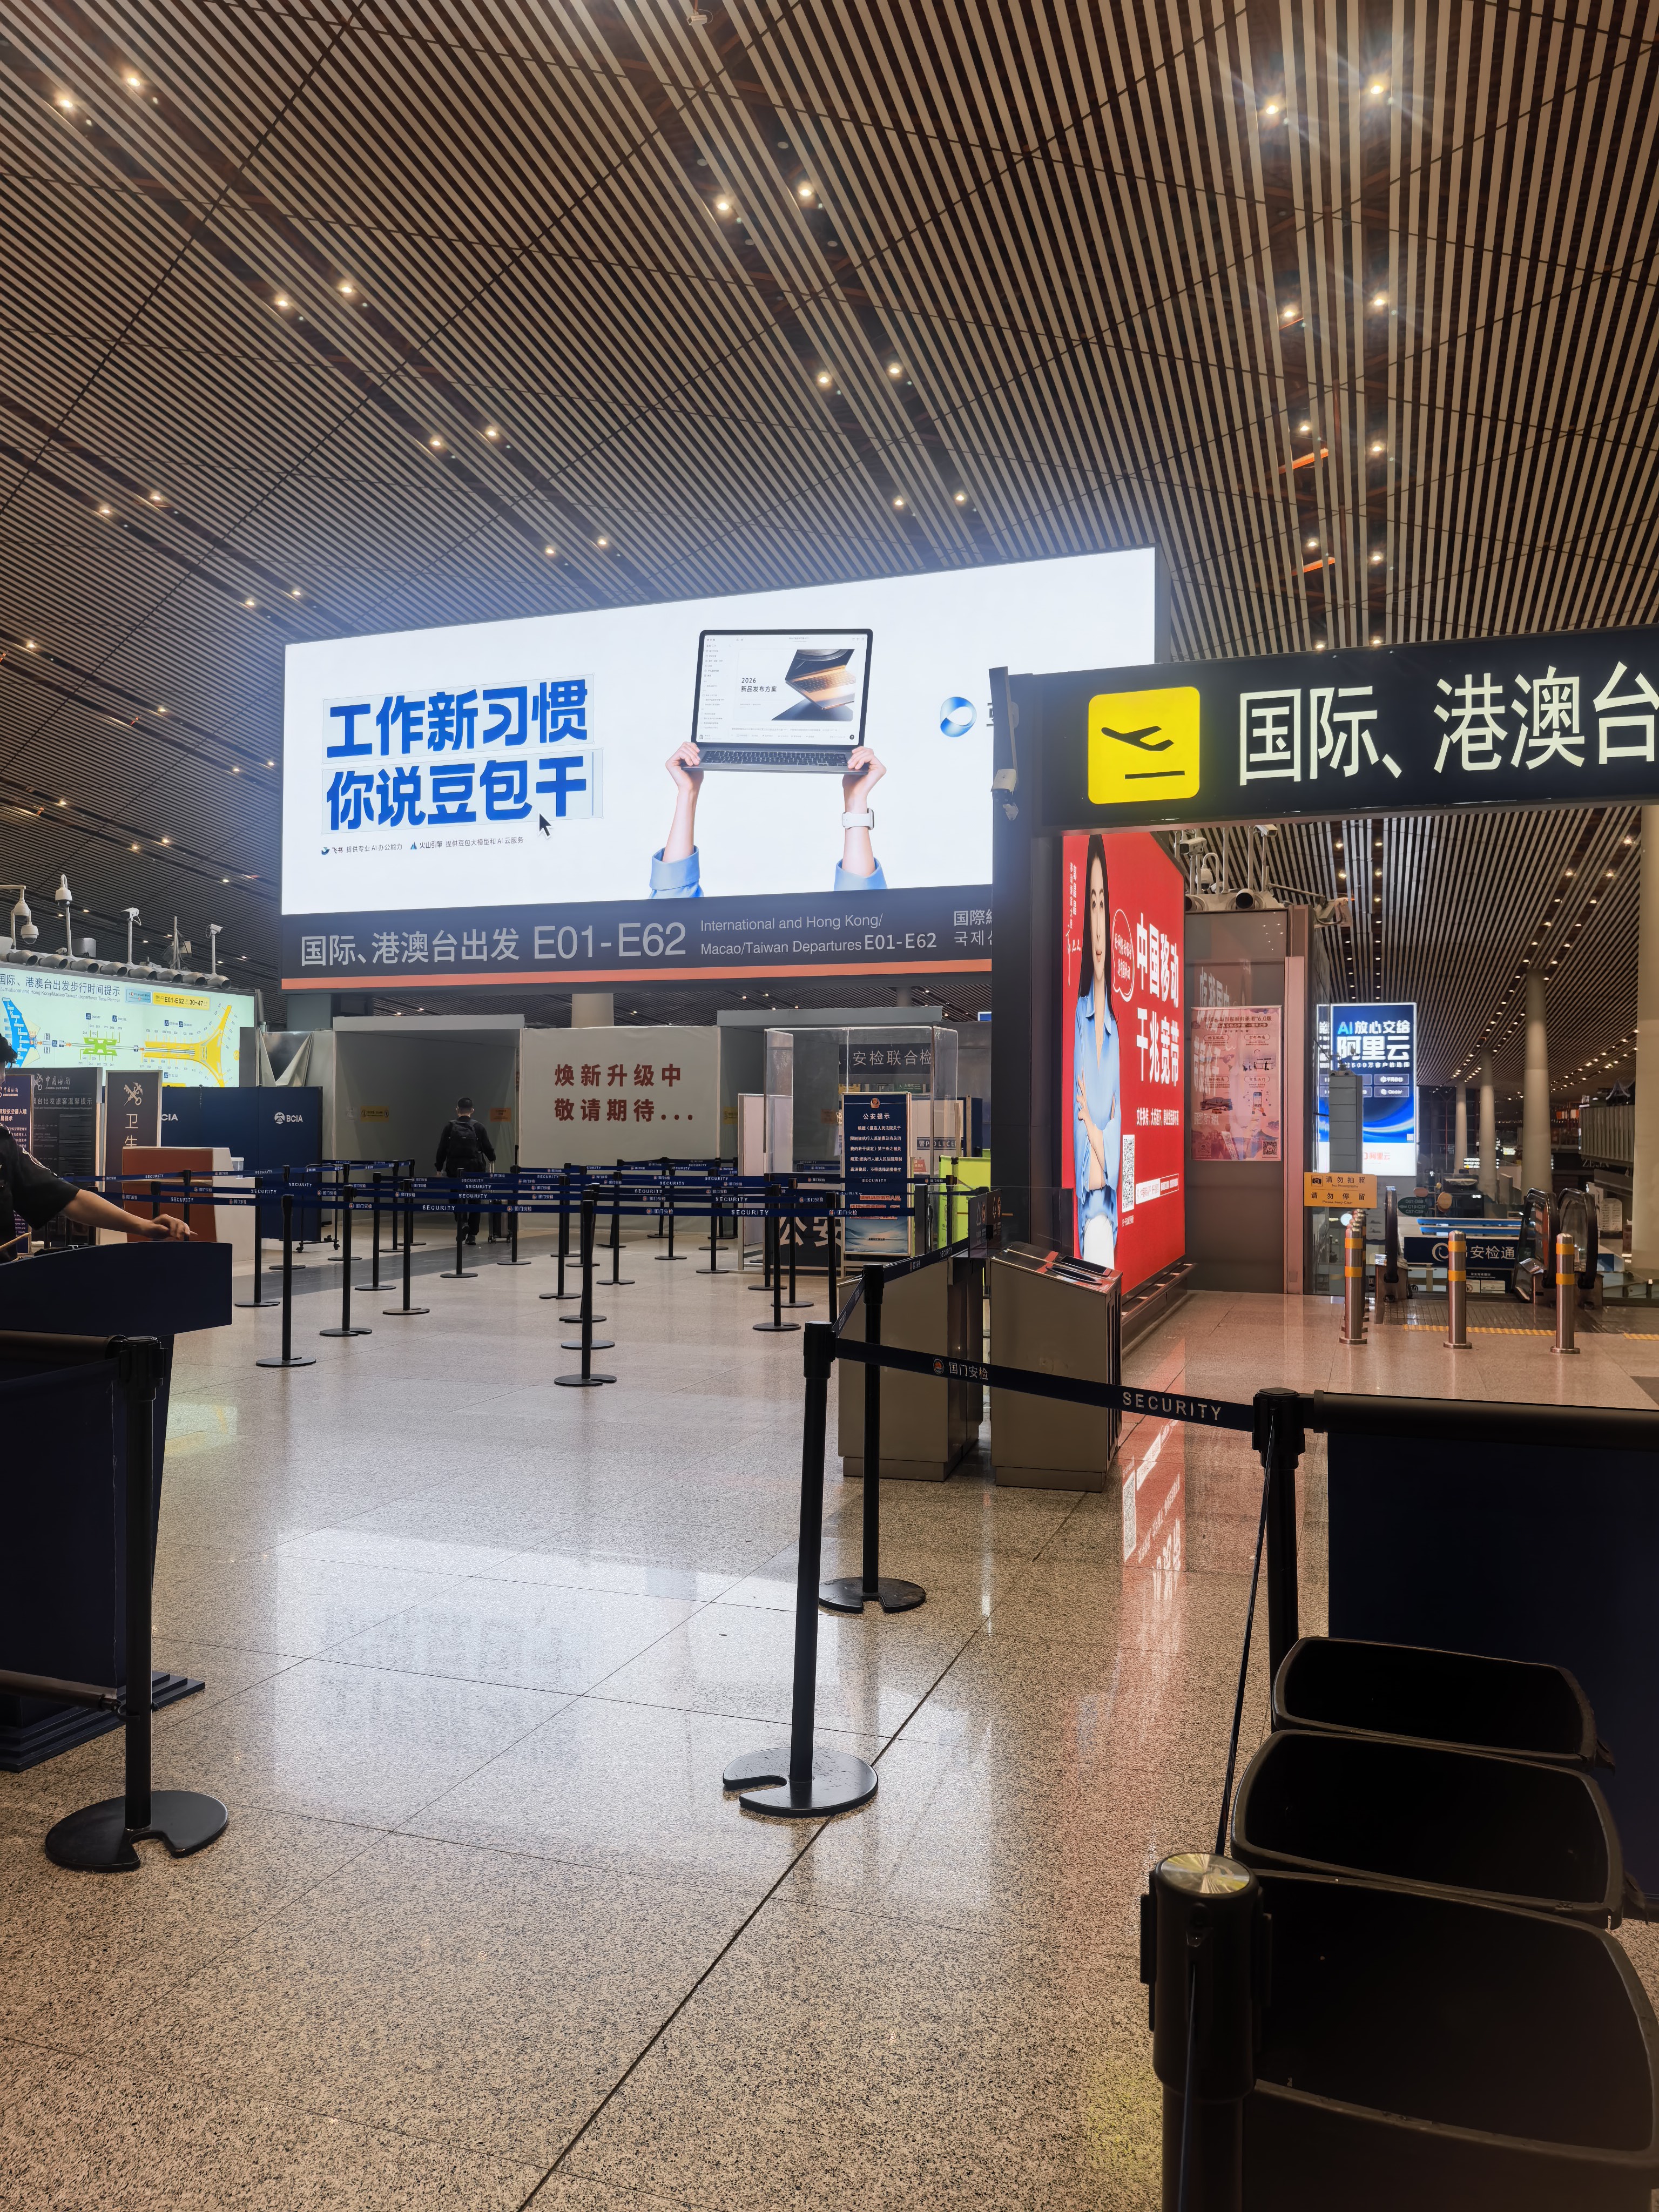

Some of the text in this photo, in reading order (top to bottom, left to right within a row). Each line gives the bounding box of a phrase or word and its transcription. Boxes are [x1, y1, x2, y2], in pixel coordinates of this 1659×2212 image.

[327, 679, 587, 758] 工作新习惯
[1239, 662, 1659, 786] 国际、港澳台
[327, 756, 586, 831] 你说豆包干
[419, 841, 443, 849] 火山引擎
[446, 838, 496, 847] 提供豆包大模型和
[504, 836, 523, 844] 云服务
[701, 913, 883, 932] International and Hong Kong/
[301, 922, 686, 966] 国际、港澳台出发 E01-E62
[701, 932, 937, 955] Macao/Taiwan Departures E01-E62
[1137, 912, 1179, 1008] 中国移动
[0, 974, 120, 996] 国际、港澳台出发步行时间提示
[164, 996, 184, 1004] E01-E62
[1337, 1020, 1410, 1035] AI放心交给
[1337, 1035, 1411, 1061] 阿里云
[554, 1063, 680, 1087] 焕新升级中
[286, 1115, 303, 1123] BCIA
[554, 1098, 693, 1122] 敬请期待...
[1369, 1151, 1391, 1161] 阿里云
[1311, 1192, 1365, 1200] 请勿停留
[1467, 1245, 1515, 1260] 安检通
[949, 1361, 988, 1381] 国门安检
[1123, 1392, 1222, 1420] SECURITY
